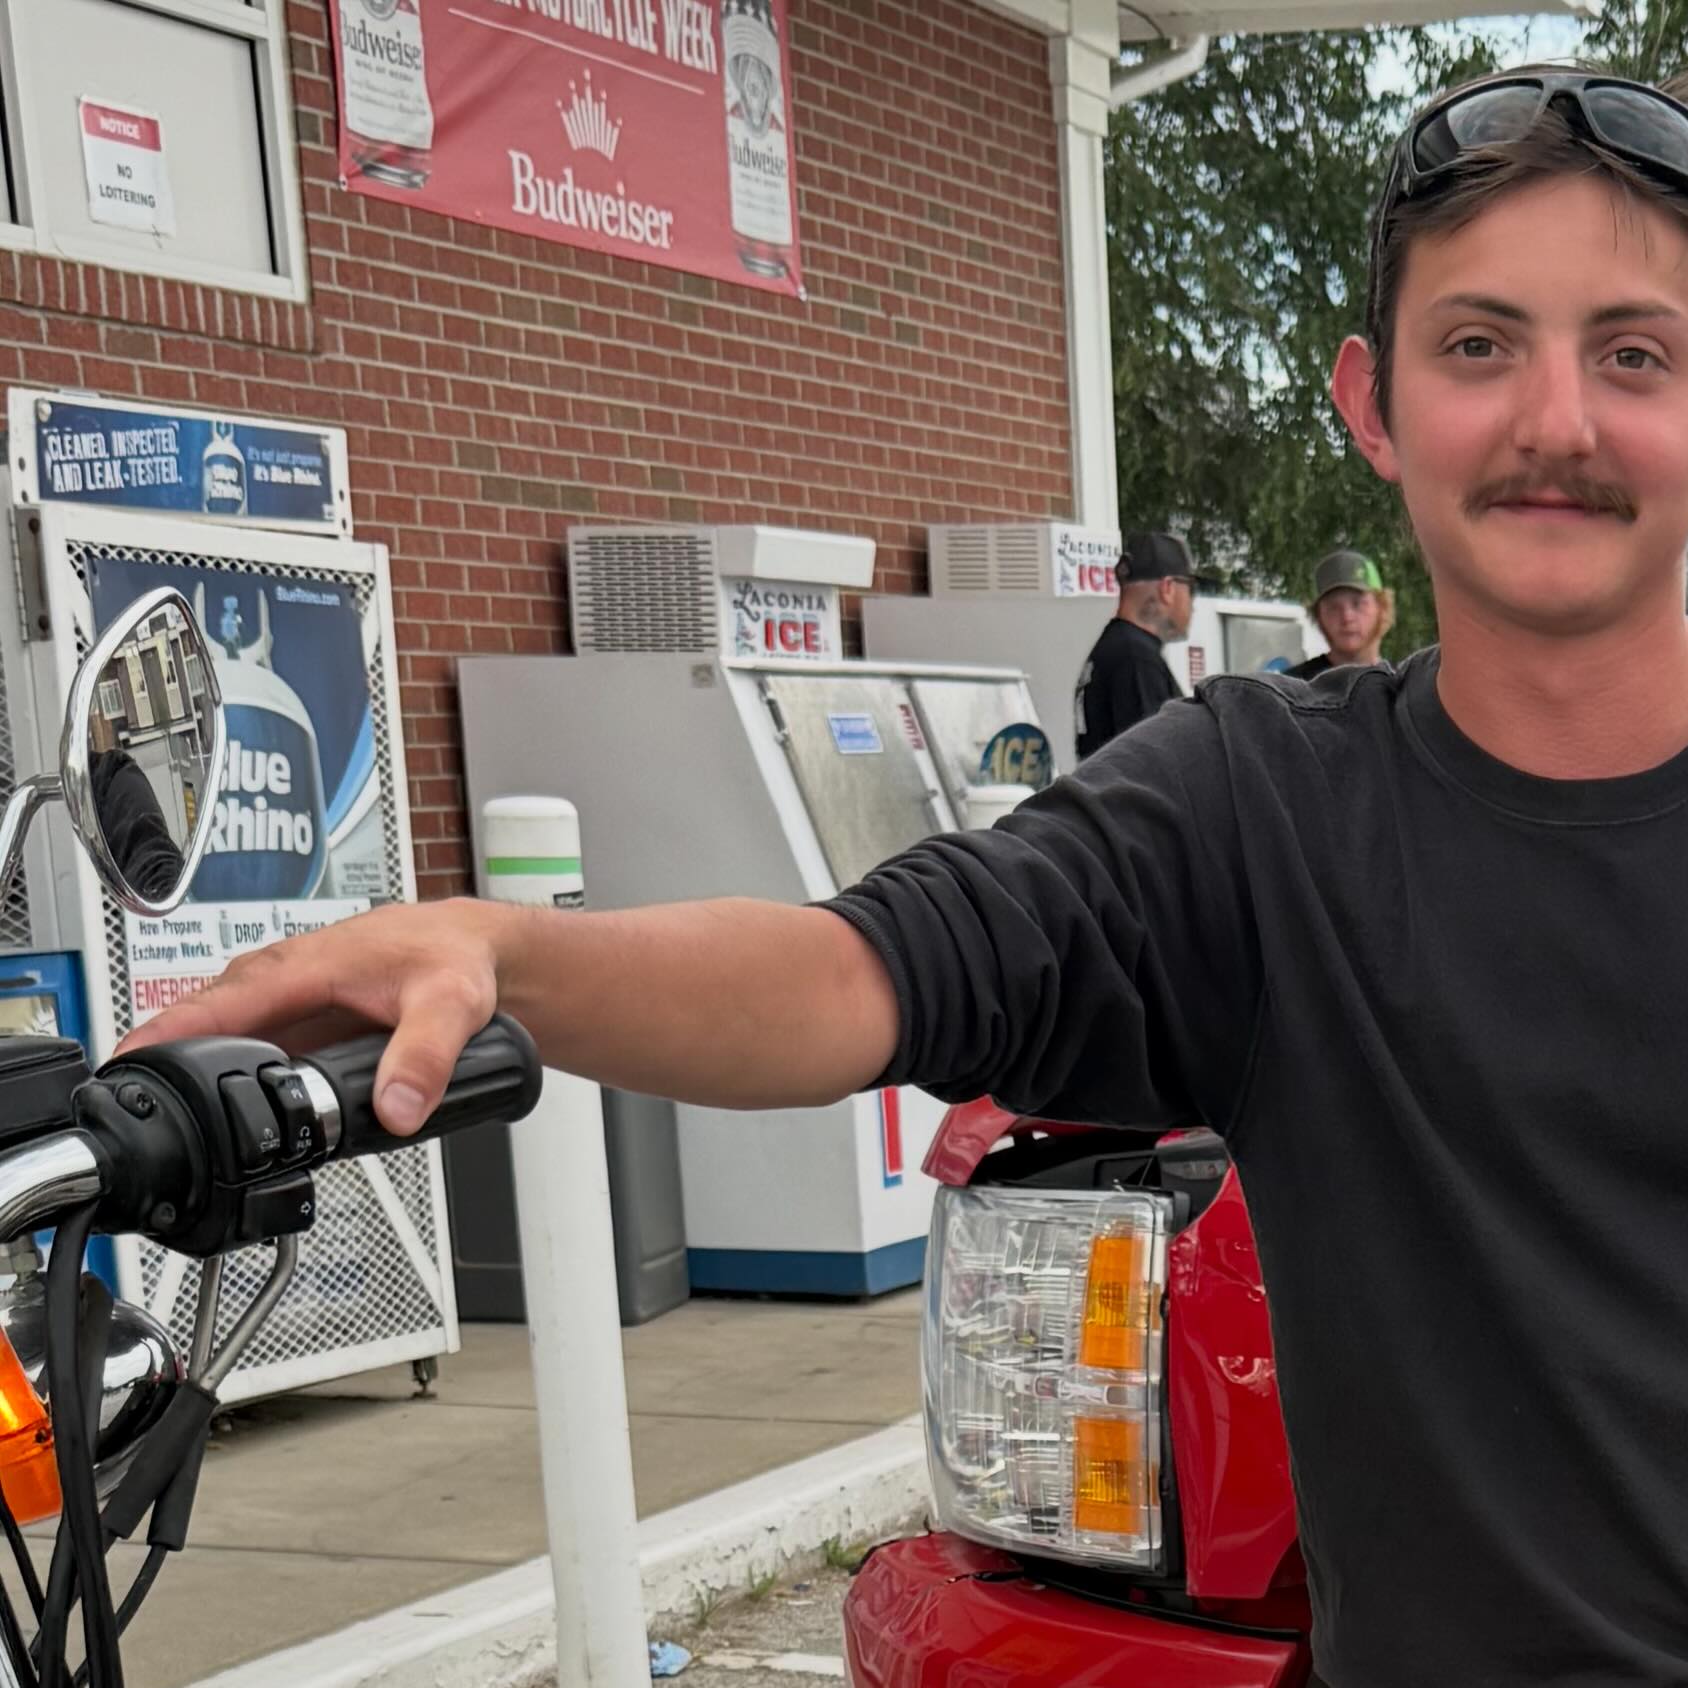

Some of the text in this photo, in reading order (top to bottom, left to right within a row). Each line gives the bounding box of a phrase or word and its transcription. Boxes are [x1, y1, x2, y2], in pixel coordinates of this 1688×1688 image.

[527, 0, 717, 75] RCYCLE WEEK
[100, 117, 141, 140] NOTICE
[117, 163, 133, 179] NO
[99, 183, 156, 209] LOITERING
[508, 150, 674, 249] Budweiser
[53, 463, 83, 493] AND
[1078, 564, 1115, 594] ICE
[733, 581, 827, 622] LACONIA
[764, 617, 820, 654] ICE
[990, 735, 1045, 785] ICE
[162, 918, 203, 938] Propane
[234, 923, 266, 944] DROP
[132, 944, 178, 963] Exchange
